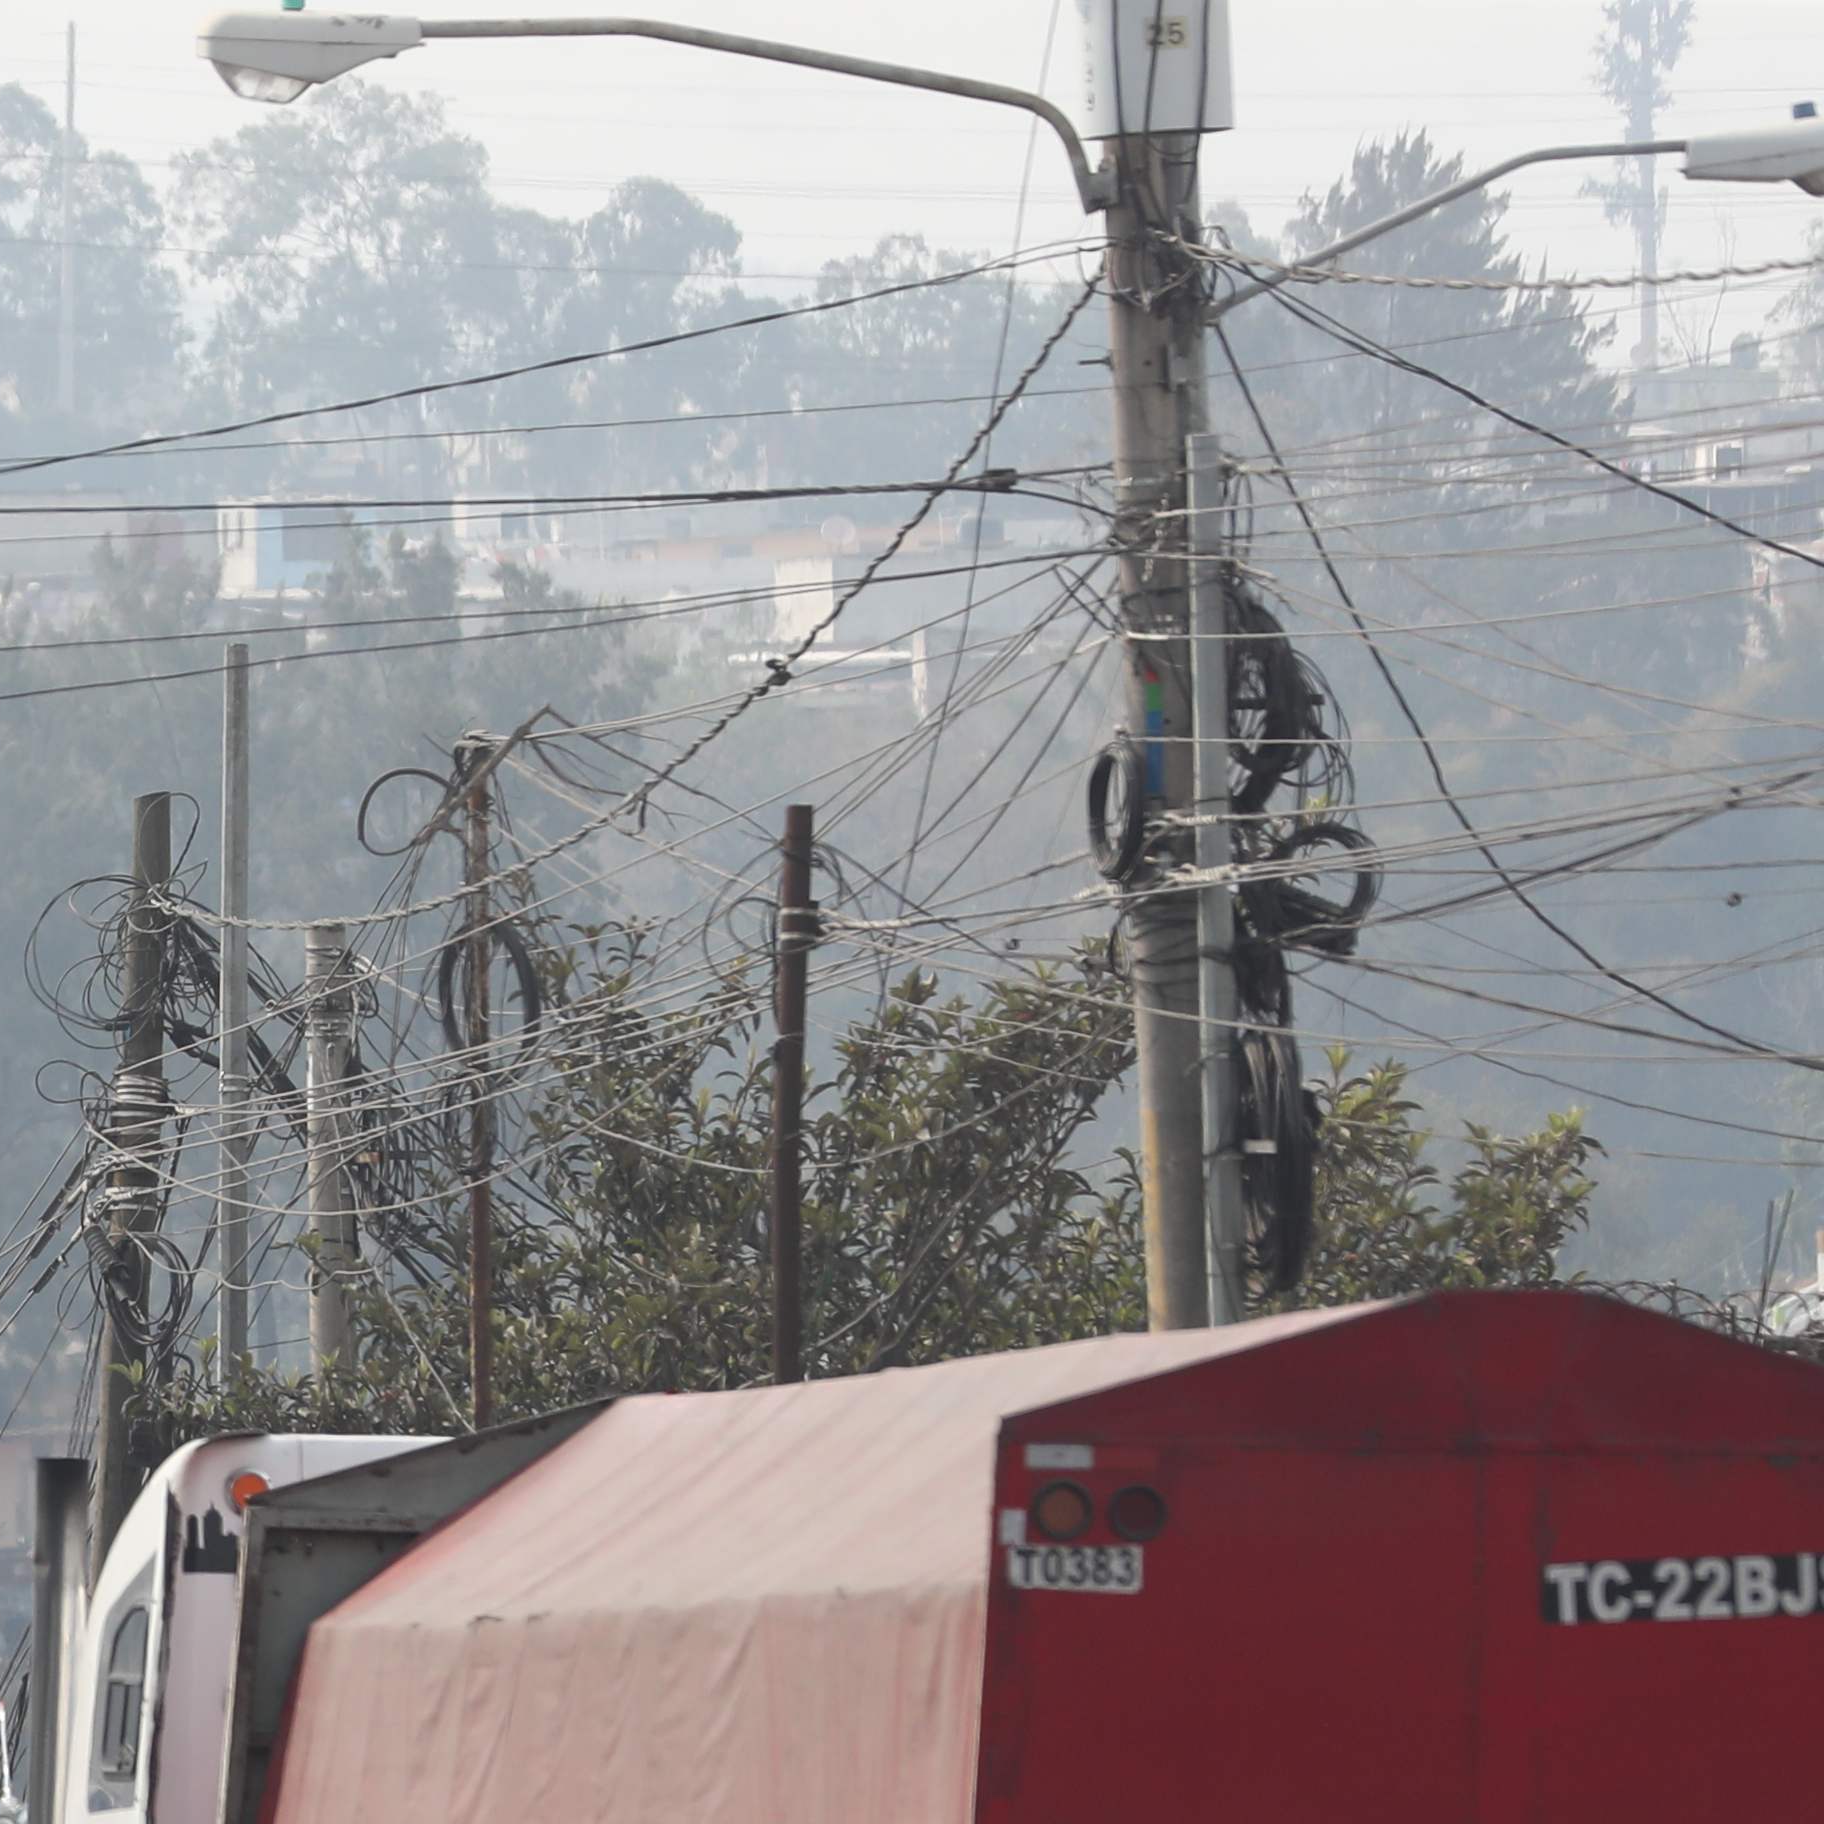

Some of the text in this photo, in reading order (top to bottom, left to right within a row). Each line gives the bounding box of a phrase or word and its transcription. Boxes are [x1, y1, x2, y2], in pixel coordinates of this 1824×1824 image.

[1146, 21, 1185, 46] 25
[1016, 1547, 1136, 1587] T0383
[1544, 1552, 1824, 1627] TC-22BJ
